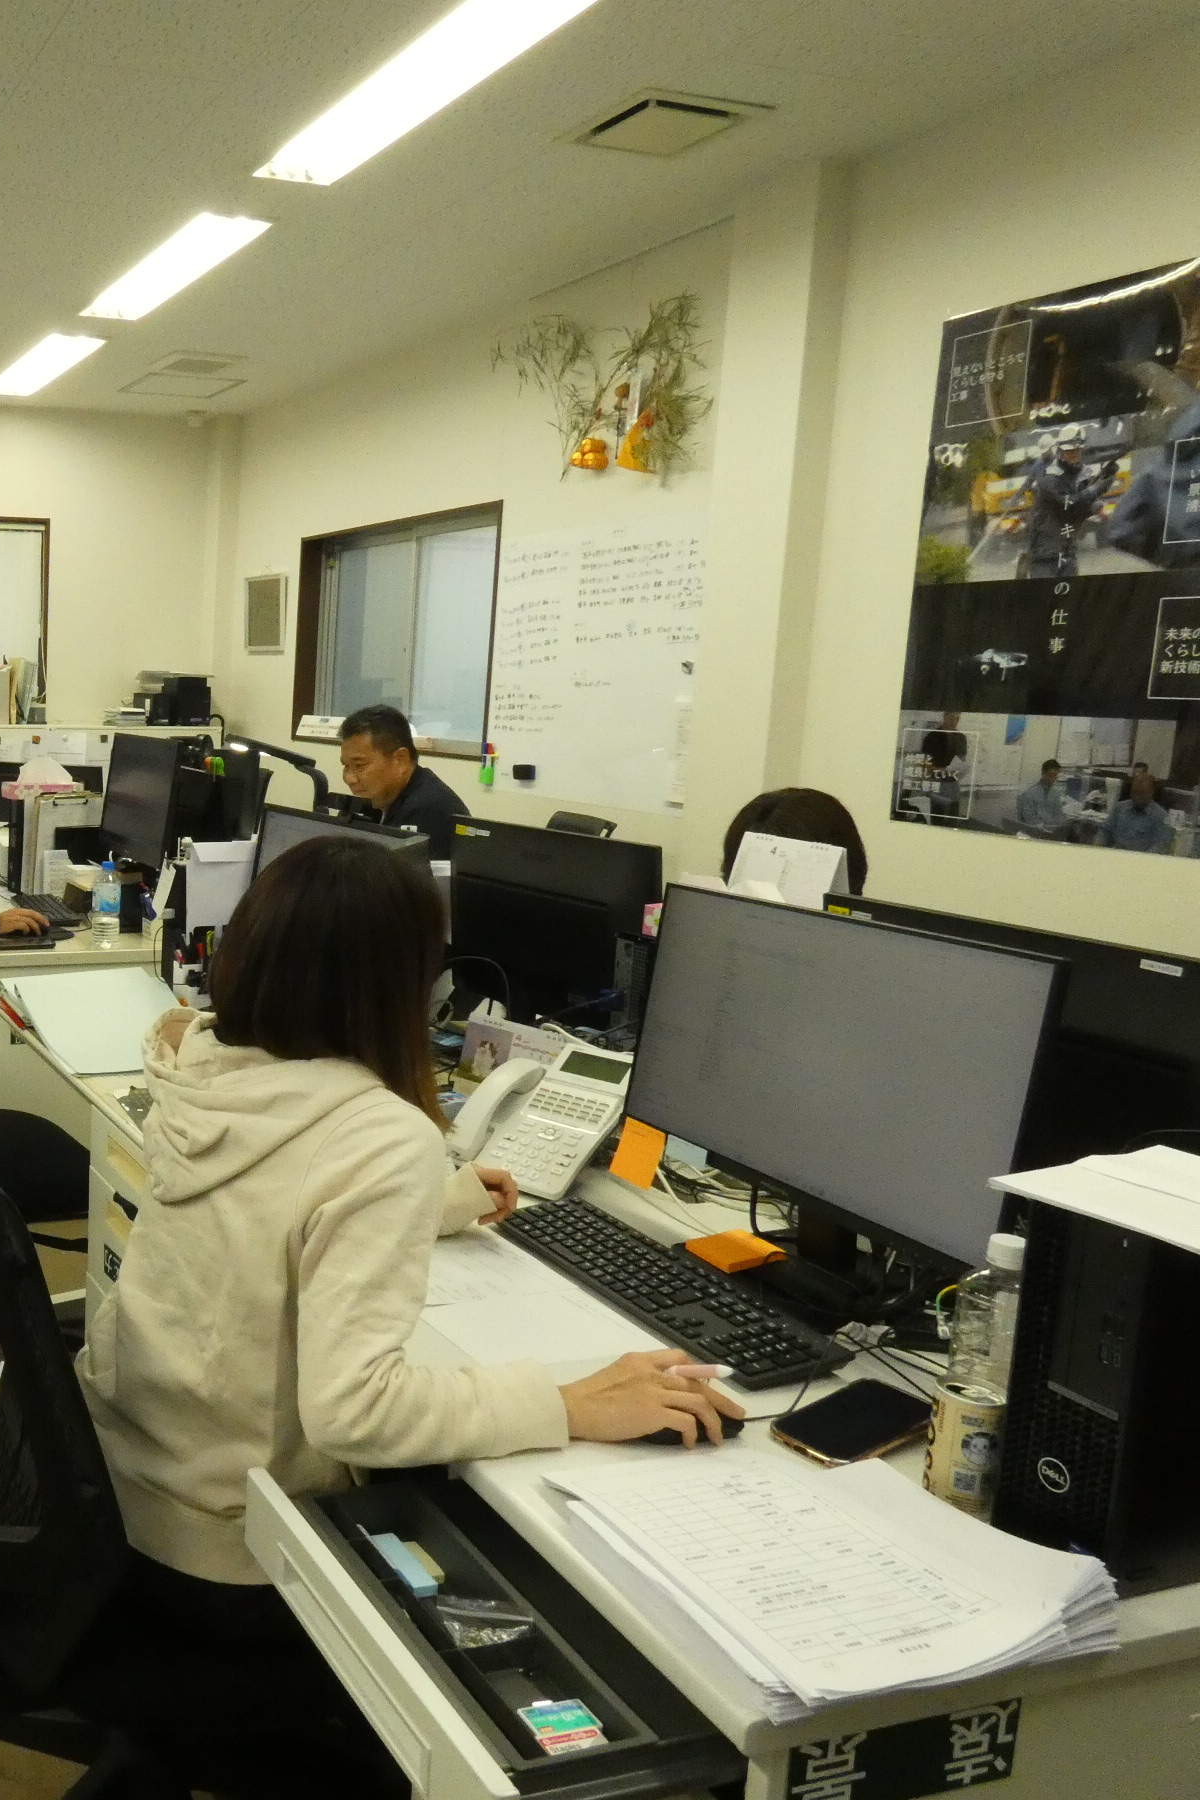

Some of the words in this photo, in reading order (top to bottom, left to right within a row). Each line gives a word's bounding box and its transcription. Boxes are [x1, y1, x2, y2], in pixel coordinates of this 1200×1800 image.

[1048, 494, 1075, 655] トキトの仕事
[1040, 1465, 1066, 1485] DELL
